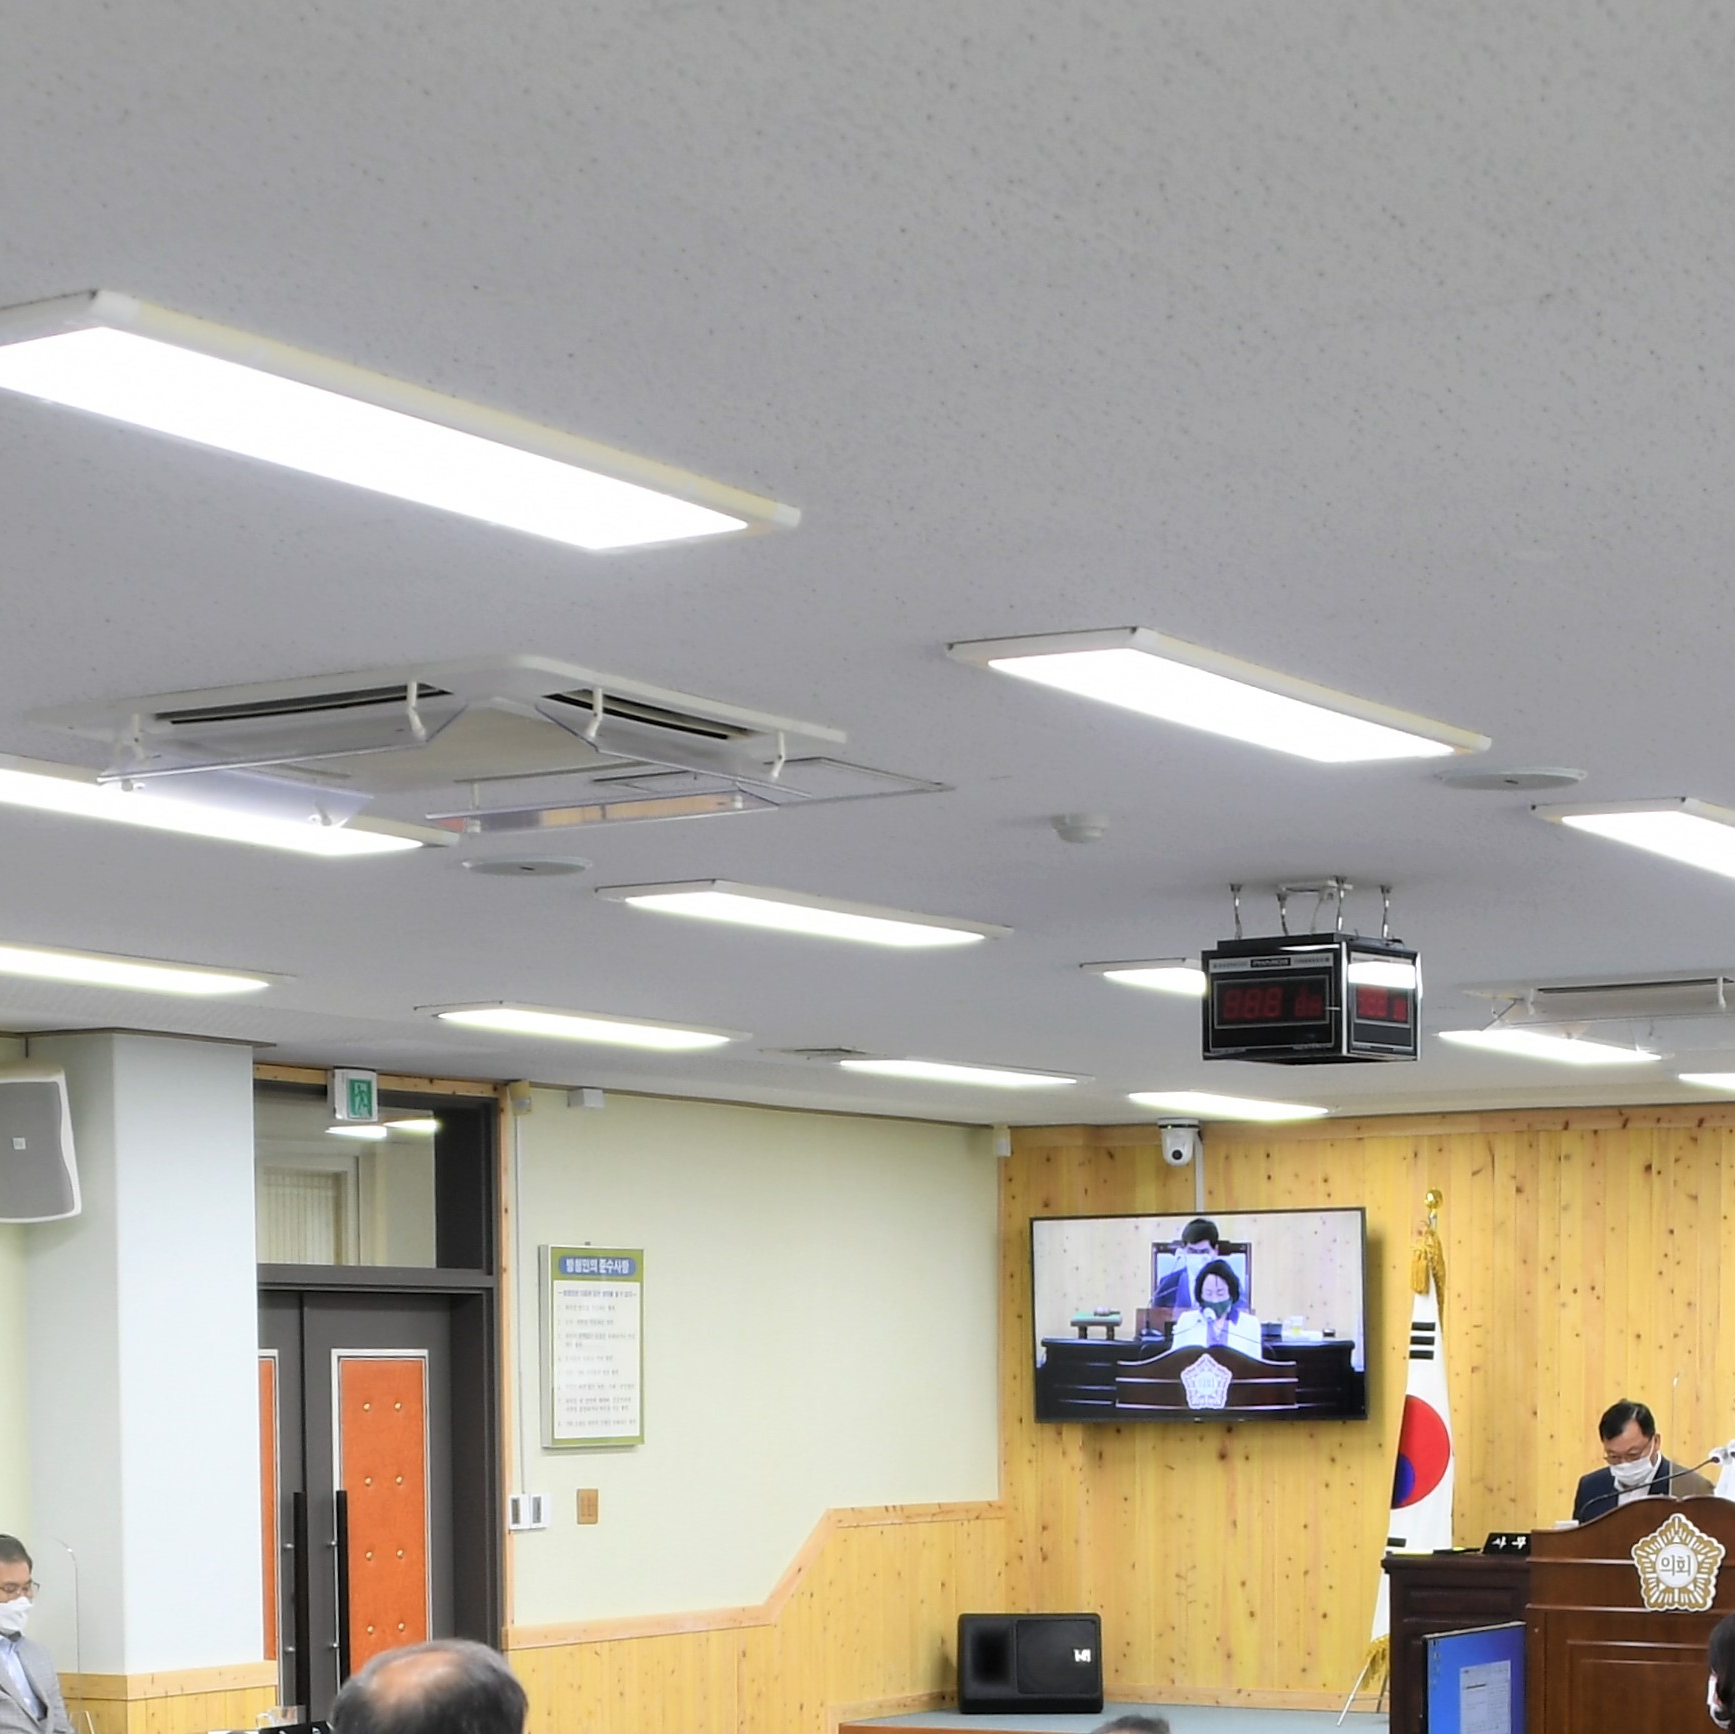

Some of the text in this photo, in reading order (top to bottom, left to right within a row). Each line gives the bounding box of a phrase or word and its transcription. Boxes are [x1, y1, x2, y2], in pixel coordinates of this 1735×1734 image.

[566, 1258, 629, 1274] 방청인의 준수사항
[1659, 1554, 1691, 1577] 의회
